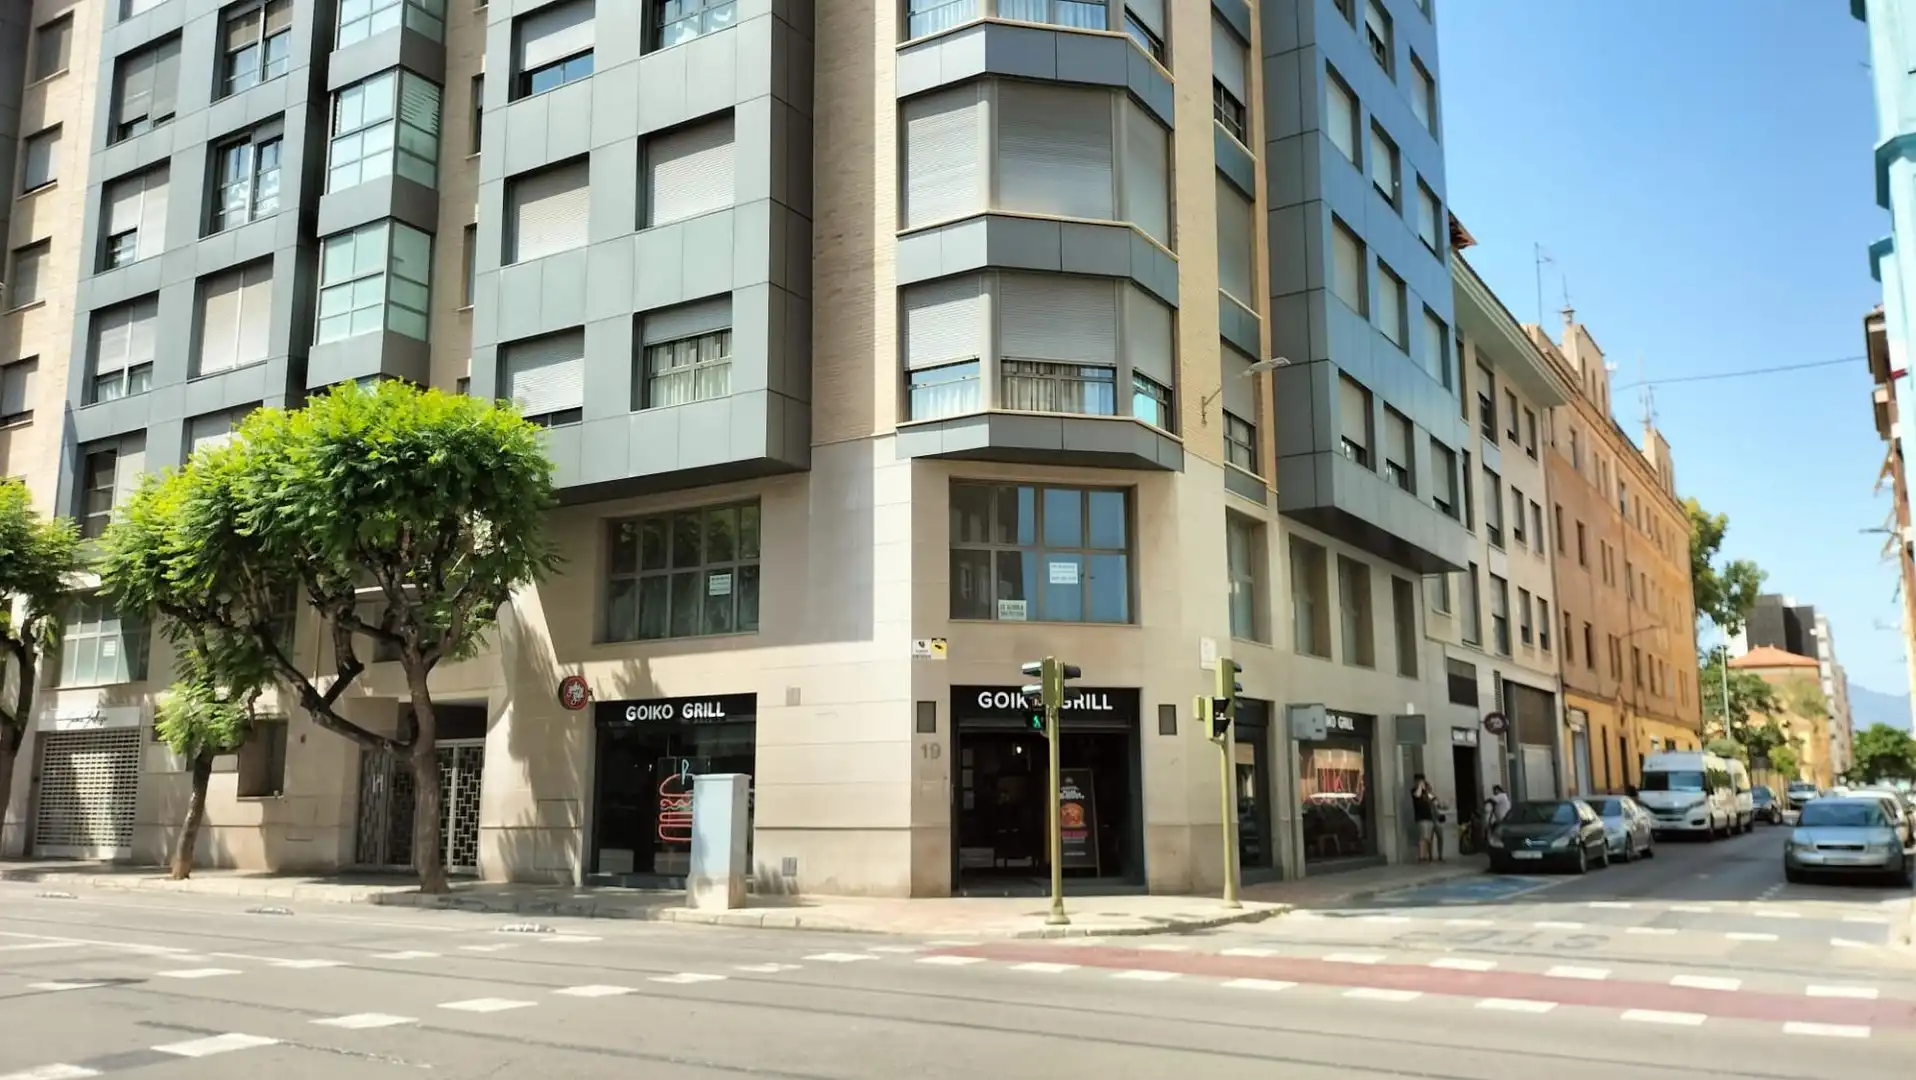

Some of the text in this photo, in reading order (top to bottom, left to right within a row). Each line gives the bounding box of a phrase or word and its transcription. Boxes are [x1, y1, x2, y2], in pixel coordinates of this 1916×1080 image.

[977, 691, 1029, 709] GOIK
[625, 701, 726, 721] GOIKO GRILL
